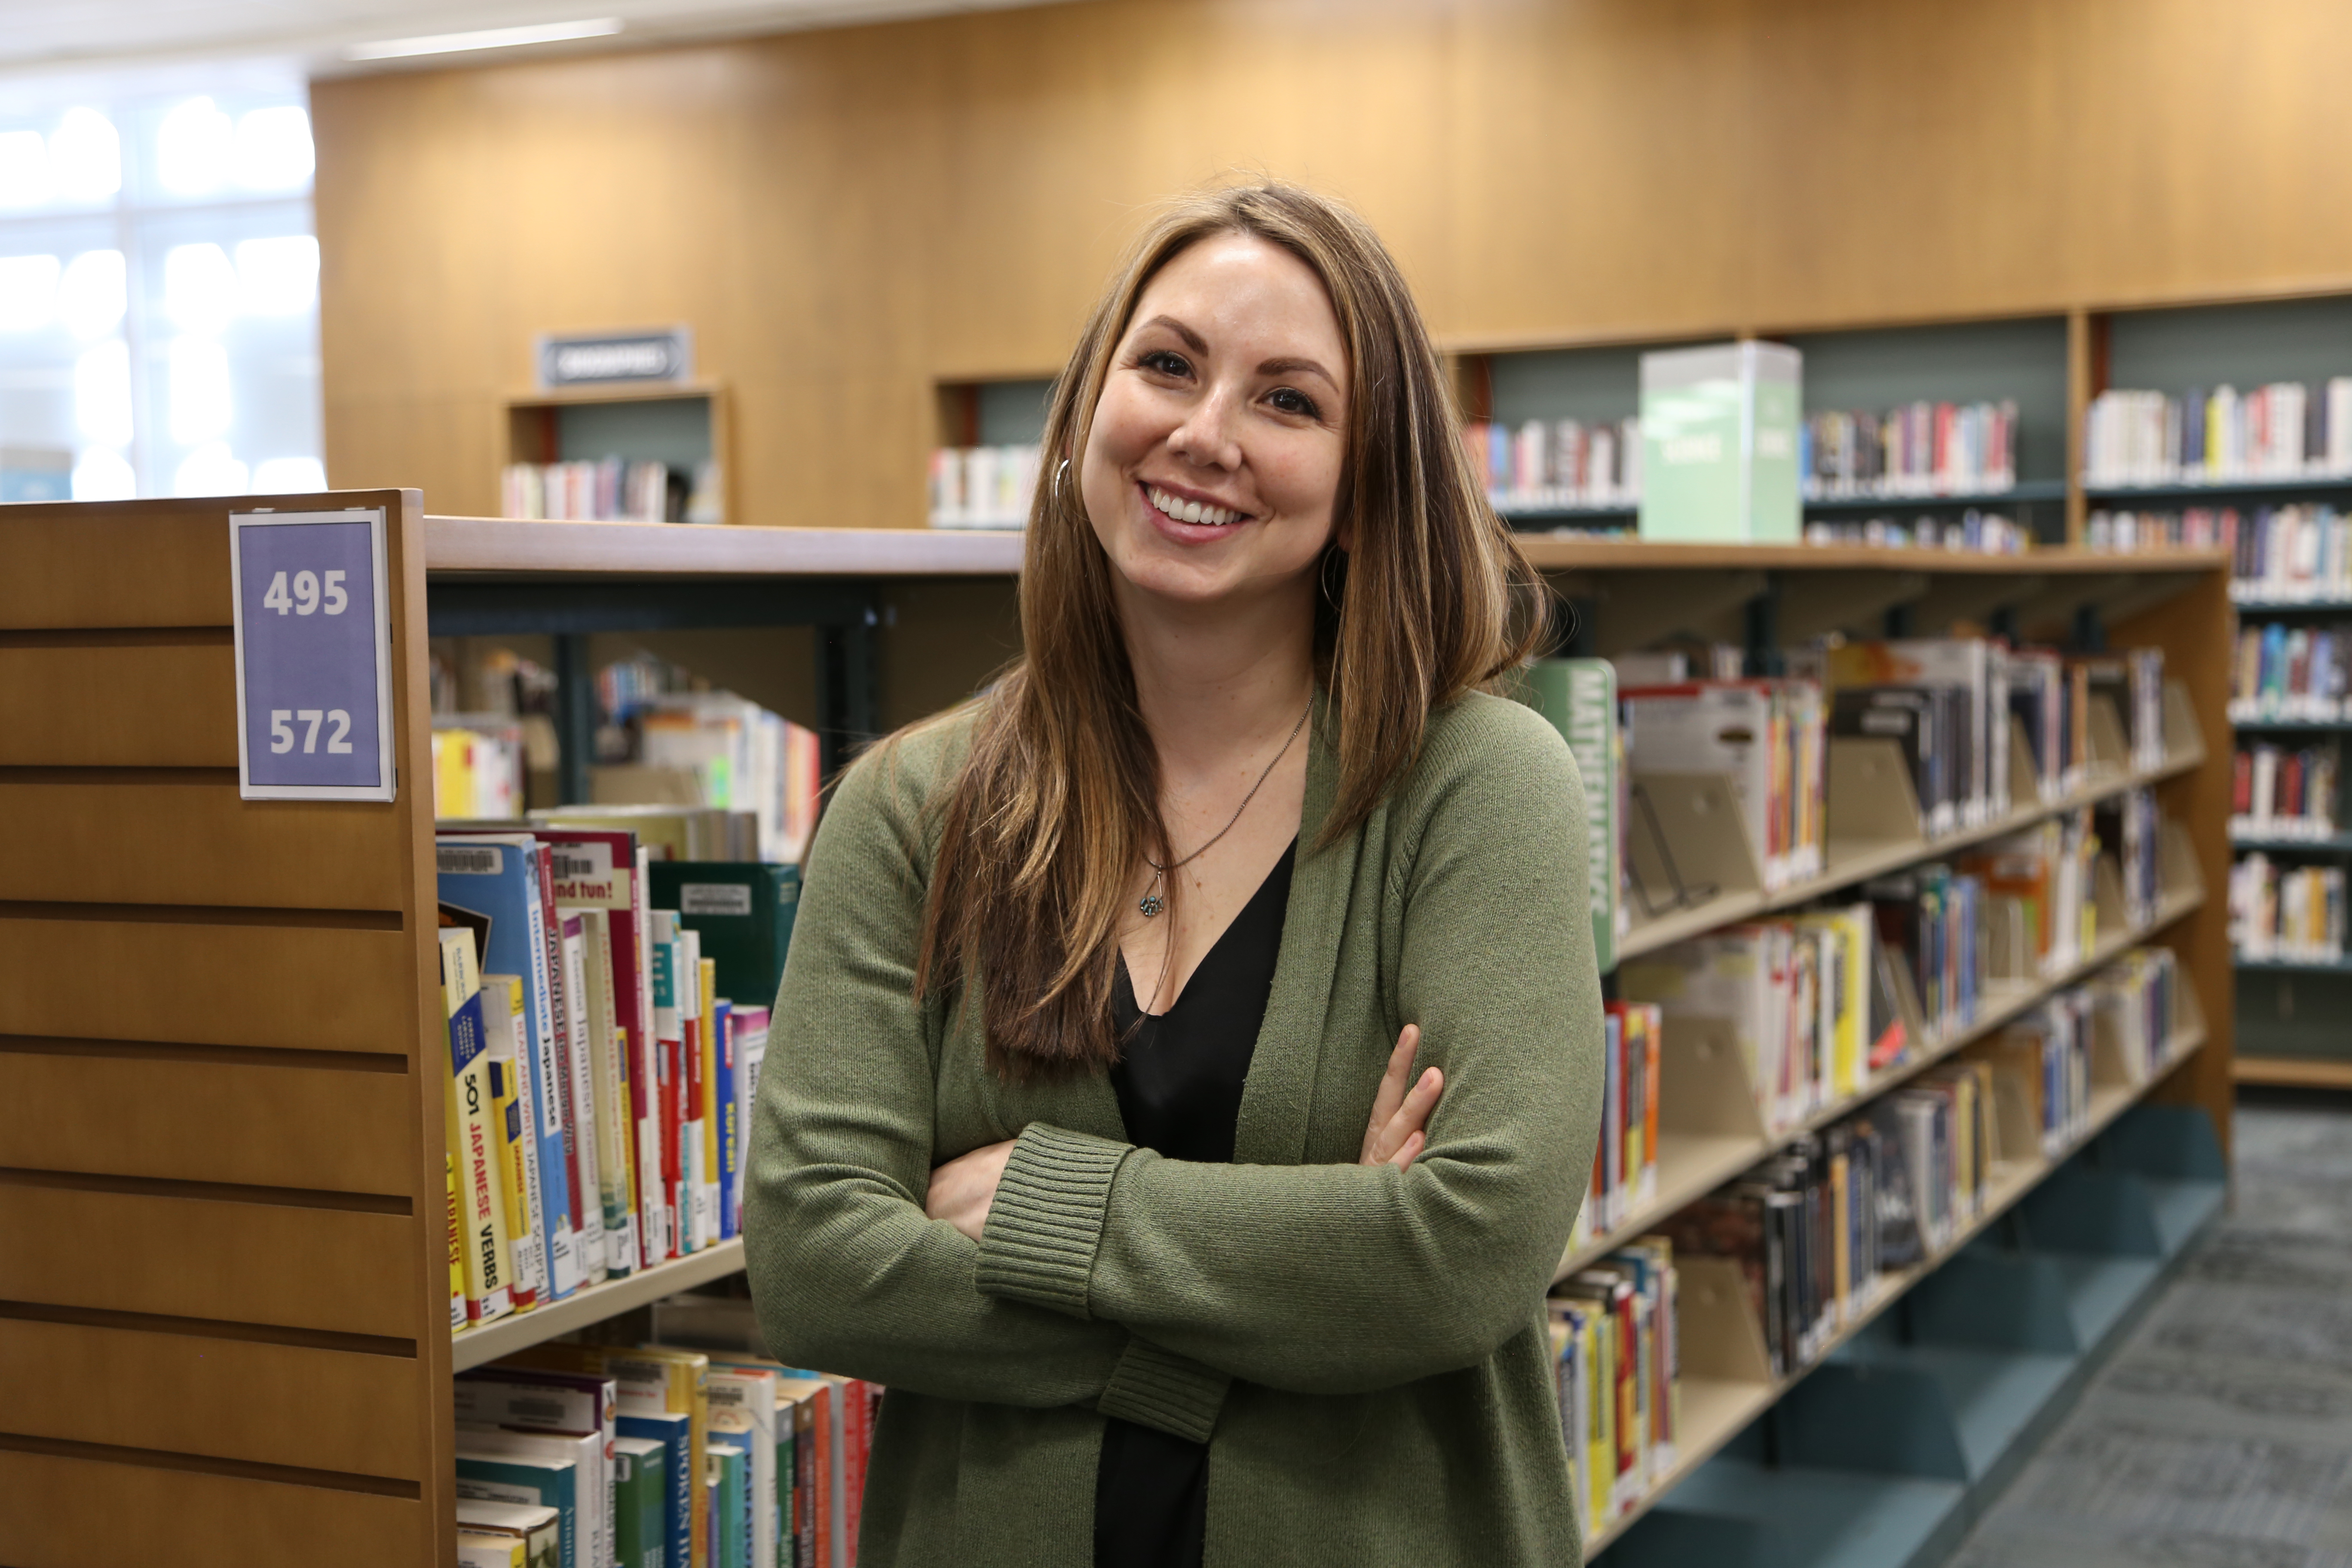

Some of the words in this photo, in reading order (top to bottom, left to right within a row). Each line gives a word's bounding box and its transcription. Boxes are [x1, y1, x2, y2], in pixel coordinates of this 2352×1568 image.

[263, 570, 348, 616] 495
[271, 709, 352, 754] 572
[555, 882, 576, 898] nd
[572, 949, 582, 1011] Essential
[457, 1024, 465, 1057] GUIDES
[461, 1015, 471, 1060] LANGUAGE
[467, 1016, 476, 1054] FOREIGN
[516, 1021, 525, 1060] READ
[532, 909, 548, 1032] Intermediate
[542, 1037, 556, 1127] Japanese
[547, 928, 566, 1033] JAPANESE
[560, 1065, 570, 1118] Manga
[565, 1121, 573, 1155] Way
[520, 1065, 528, 1096] AND
[576, 1019, 591, 1115] Japanese
[465, 1074, 480, 1115] 501
[523, 1099, 533, 1146] WRITE
[725, 1102, 735, 1173] Korean
[469, 1122, 492, 1221] JAPANESE
[514, 1145, 524, 1194] JAPANESE
[527, 1153, 539, 1221] JAPANESE
[480, 1223, 498, 1289] VERBS
[532, 1225, 546, 1289] SCRIPTS
